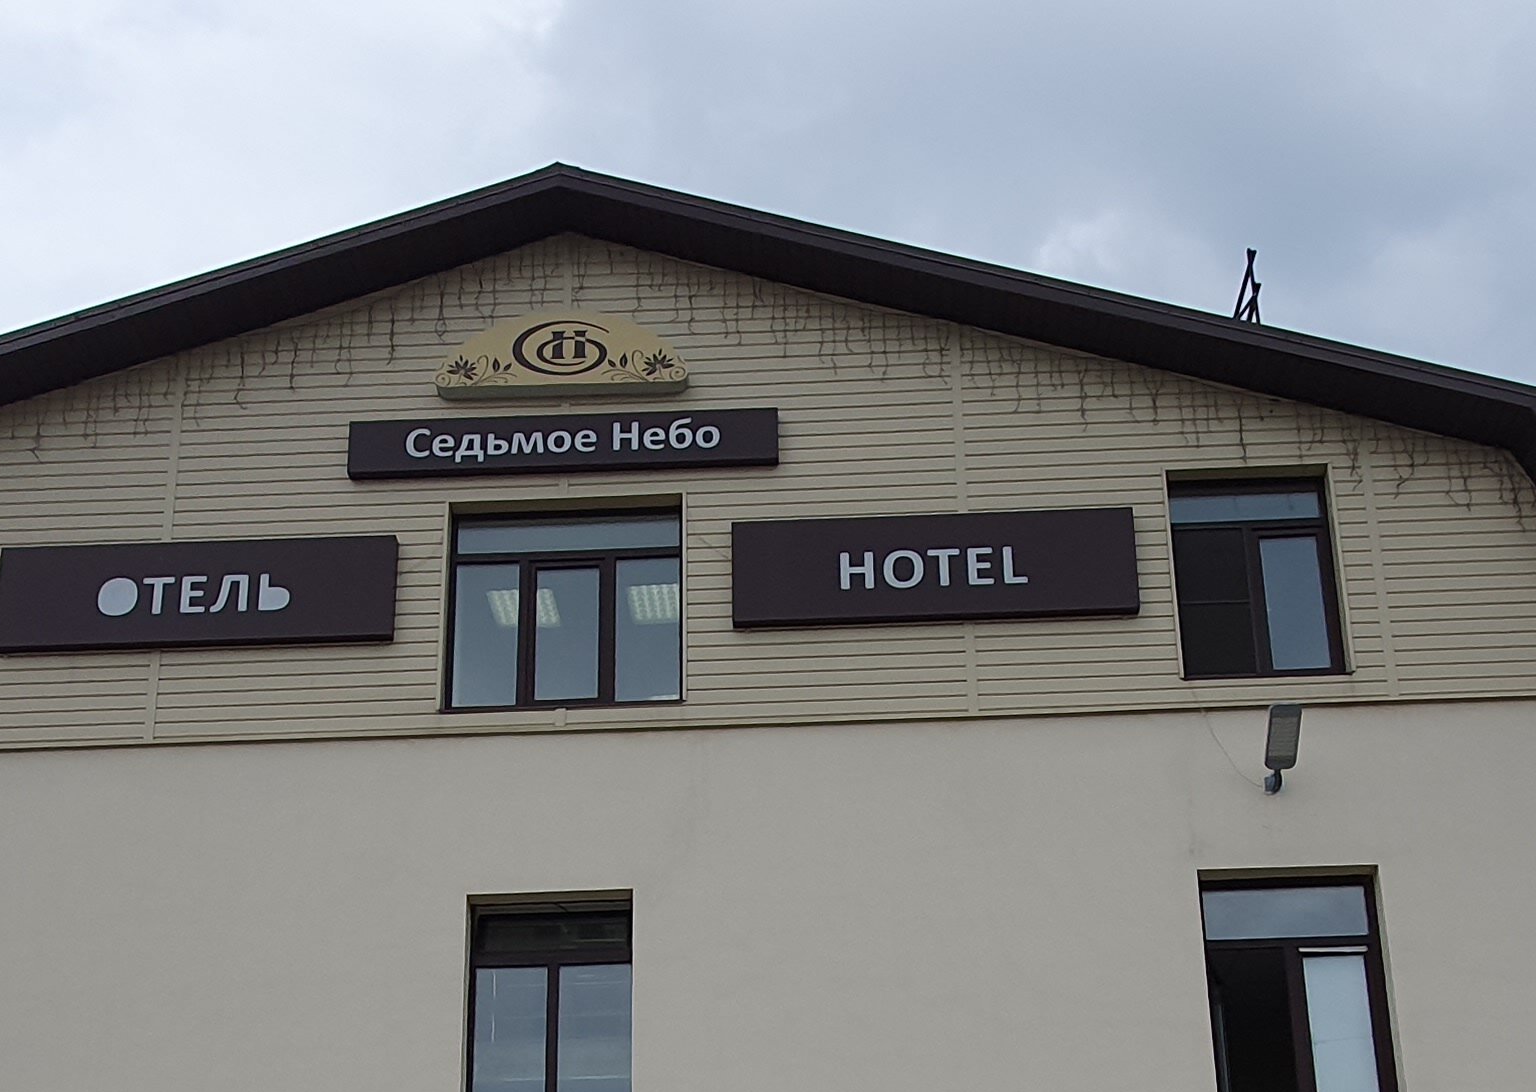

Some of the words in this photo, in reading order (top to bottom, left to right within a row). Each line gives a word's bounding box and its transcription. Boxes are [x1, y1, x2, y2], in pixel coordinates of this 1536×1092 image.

[404, 427, 598, 463] Седьмое
[611, 417, 721, 452] Небо
[839, 545, 1029, 590] HOTEL
[97, 572, 291, 617] ОТЕЛЬ
